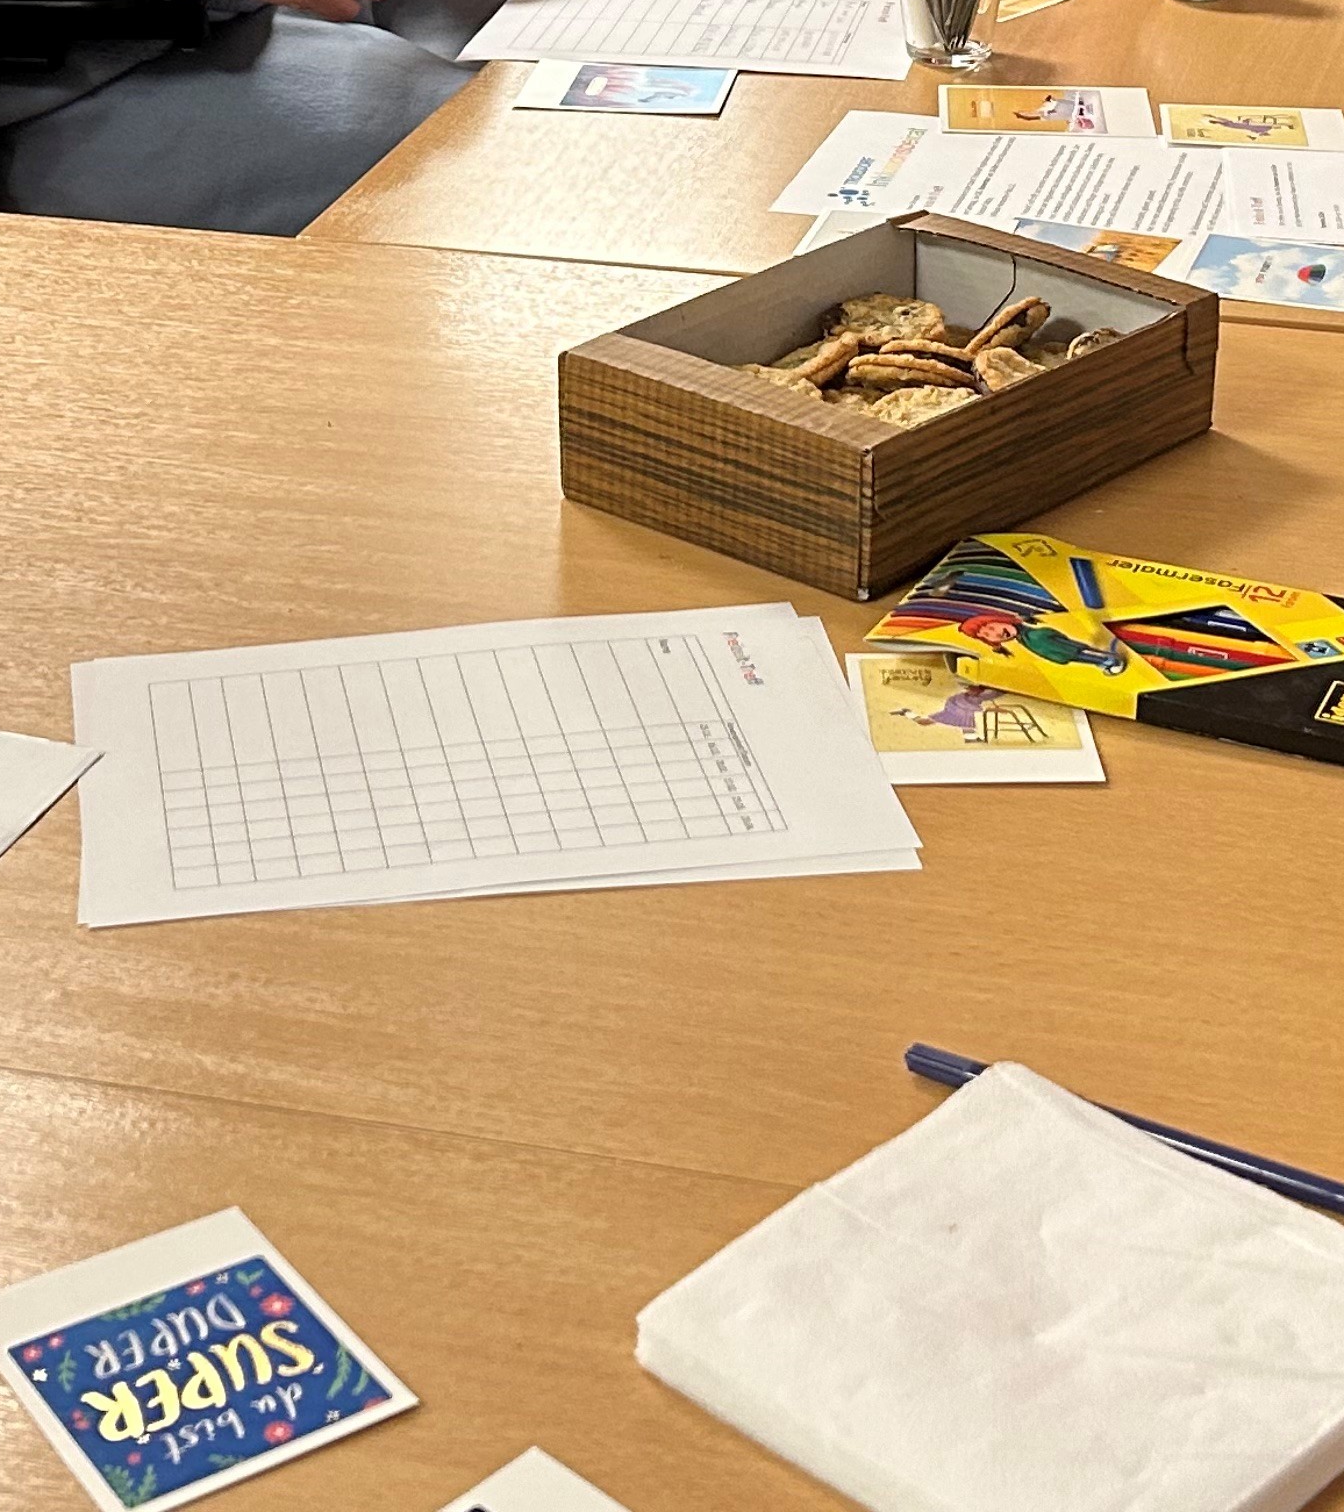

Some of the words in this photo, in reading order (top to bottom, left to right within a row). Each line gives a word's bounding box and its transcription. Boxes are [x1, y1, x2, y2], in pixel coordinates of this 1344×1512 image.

[84, 1293, 247, 1380] DUPER
[81, 1320, 316, 1442] SUPER
[251, 1382, 303, 1420] du
[161, 1409, 246, 1465] bist
